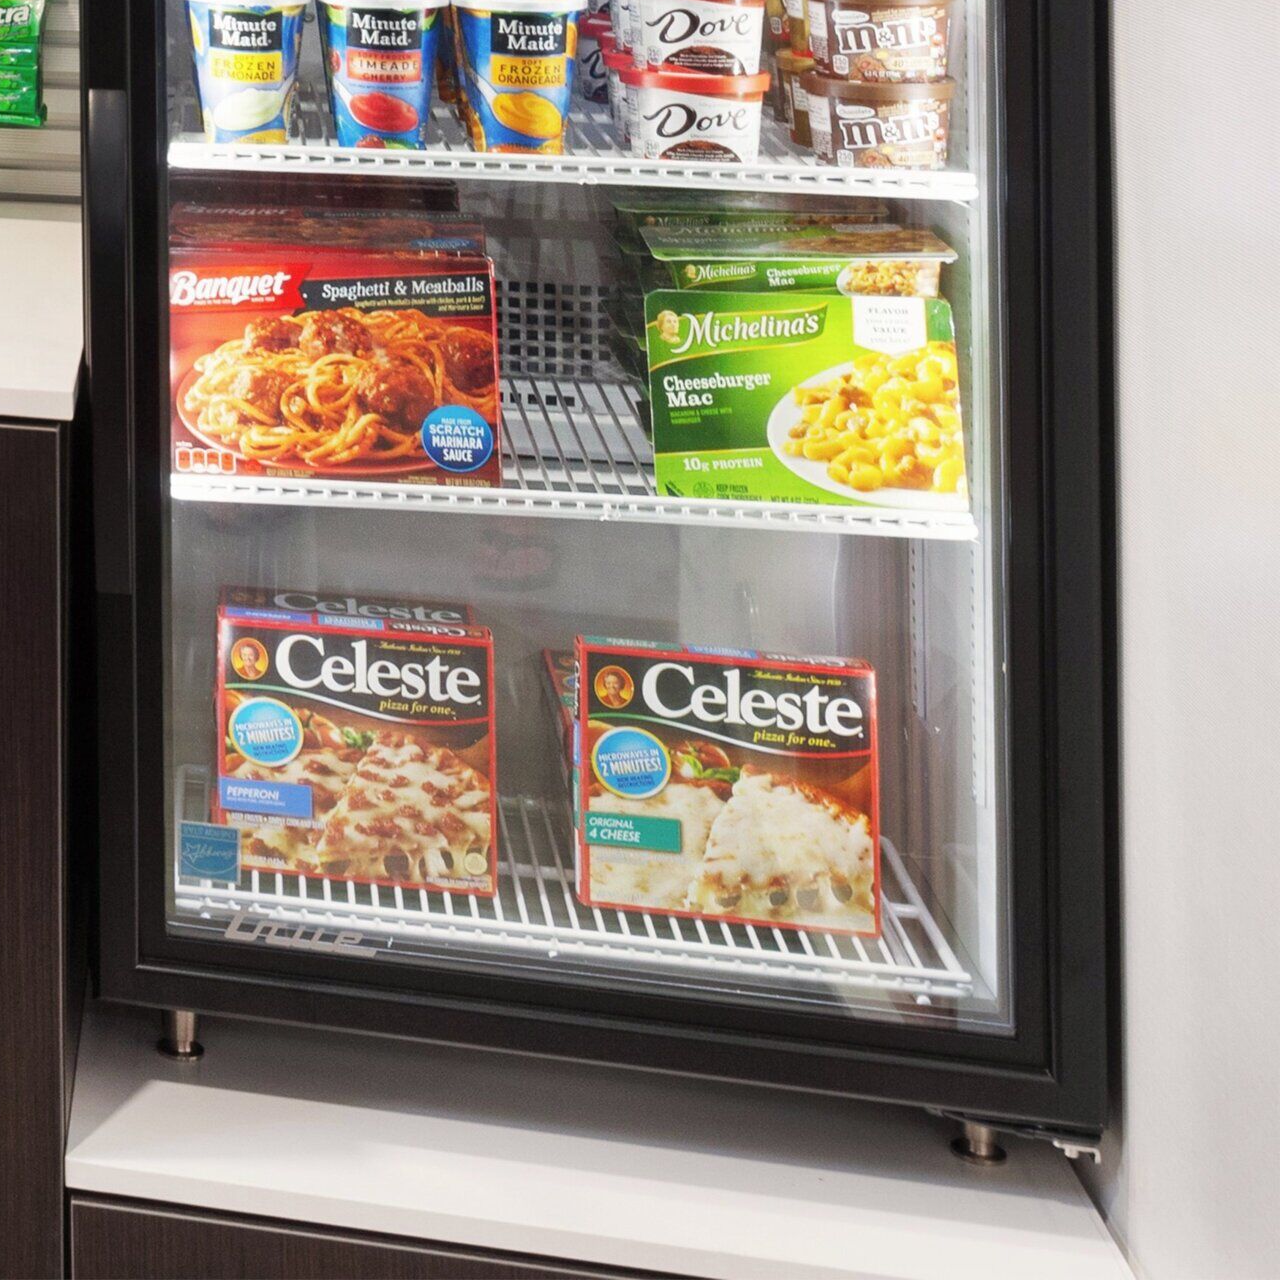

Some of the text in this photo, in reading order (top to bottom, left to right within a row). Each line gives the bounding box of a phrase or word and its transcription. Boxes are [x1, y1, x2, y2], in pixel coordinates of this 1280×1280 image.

[213, 12, 277, 33] Minute
[351, 12, 418, 33] Minute
[498, 18, 563, 36] Minute
[221, 29, 270, 48] Maid
[360, 29, 408, 48] Maid
[507, 34, 556, 52] Maid
[361, 72, 407, 82] CHERRY
[499, 64, 562, 76] FROZEN
[497, 74, 562, 86] ORANGEADE
[695, 264, 757, 282] Michelina's
[766, 263, 841, 280] Cheeseburger
[171, 270, 292, 307] Banquet
[321, 276, 485, 302] Spaghetti & Meatballs
[768, 277, 796, 288] Mac
[670, 311, 820, 354] Michelina's
[663, 372, 772, 392] Cheeseburger
[666, 391, 714, 408] Mac
[429, 424, 486, 438] SCRATCH
[432, 435, 484, 451] MARINARA
[443, 448, 474, 463] SAUCE
[713, 458, 763, 470] PROTEIN
[276, 634, 482, 706] Celeste
[380, 698, 452, 715] pizza for one
[642, 662, 864, 737] Celeste
[238, 726, 297, 746] 2 MINUTES!
[753, 729, 830, 749] pizza for one
[598, 751, 650, 763] MICROWAVES
[600, 756, 663, 777] 2 MINUTES!
[227, 785, 280, 802] PEPPERONI
[589, 816, 635, 830] ORIGINAL
[589, 827, 641, 843] 4 CHEESE
